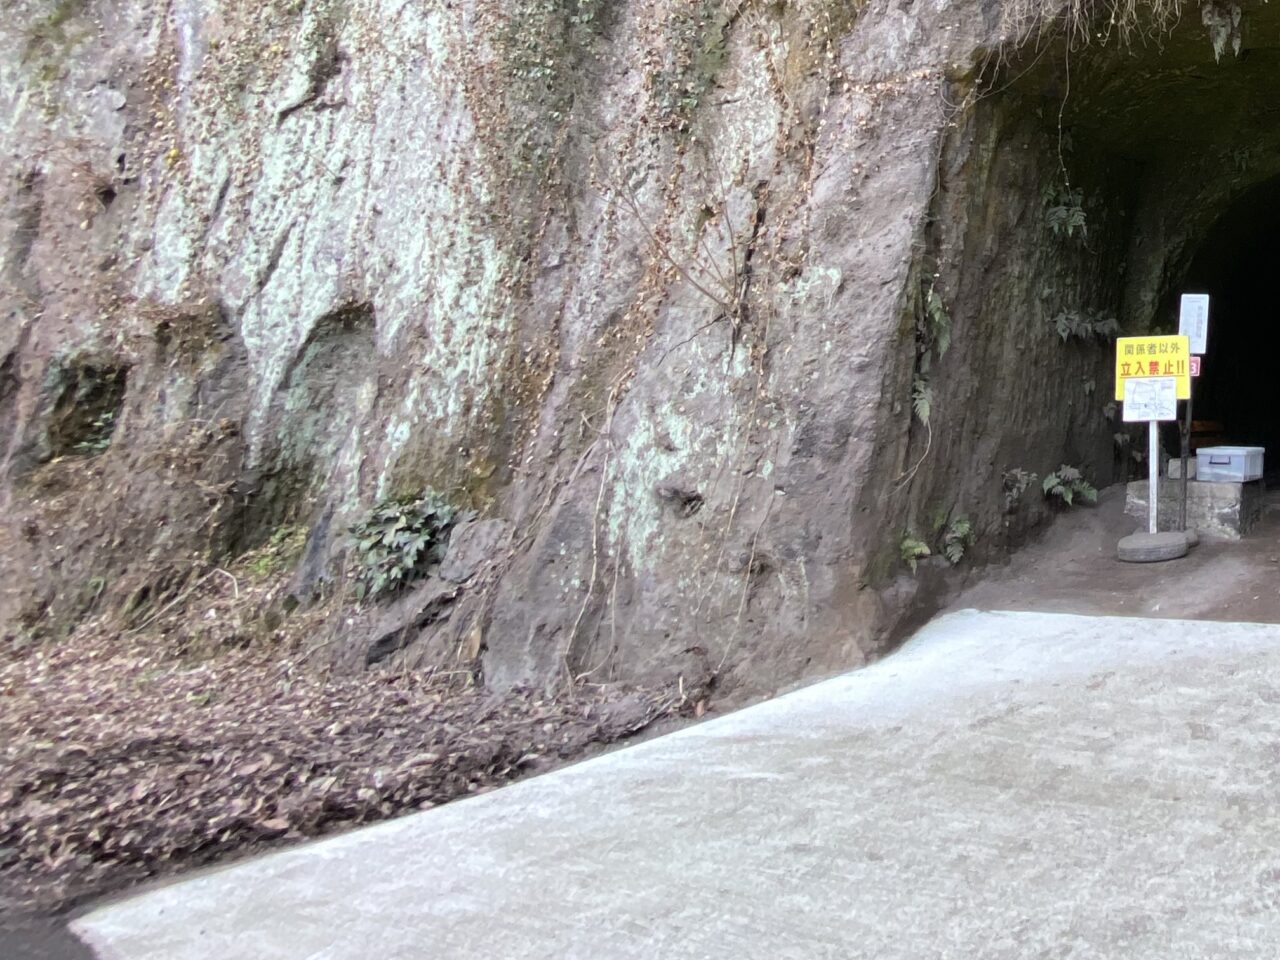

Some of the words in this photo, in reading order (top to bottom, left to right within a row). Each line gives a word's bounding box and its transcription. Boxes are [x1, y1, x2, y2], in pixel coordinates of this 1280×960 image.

[1124, 342, 1180, 355] 関係者以外
